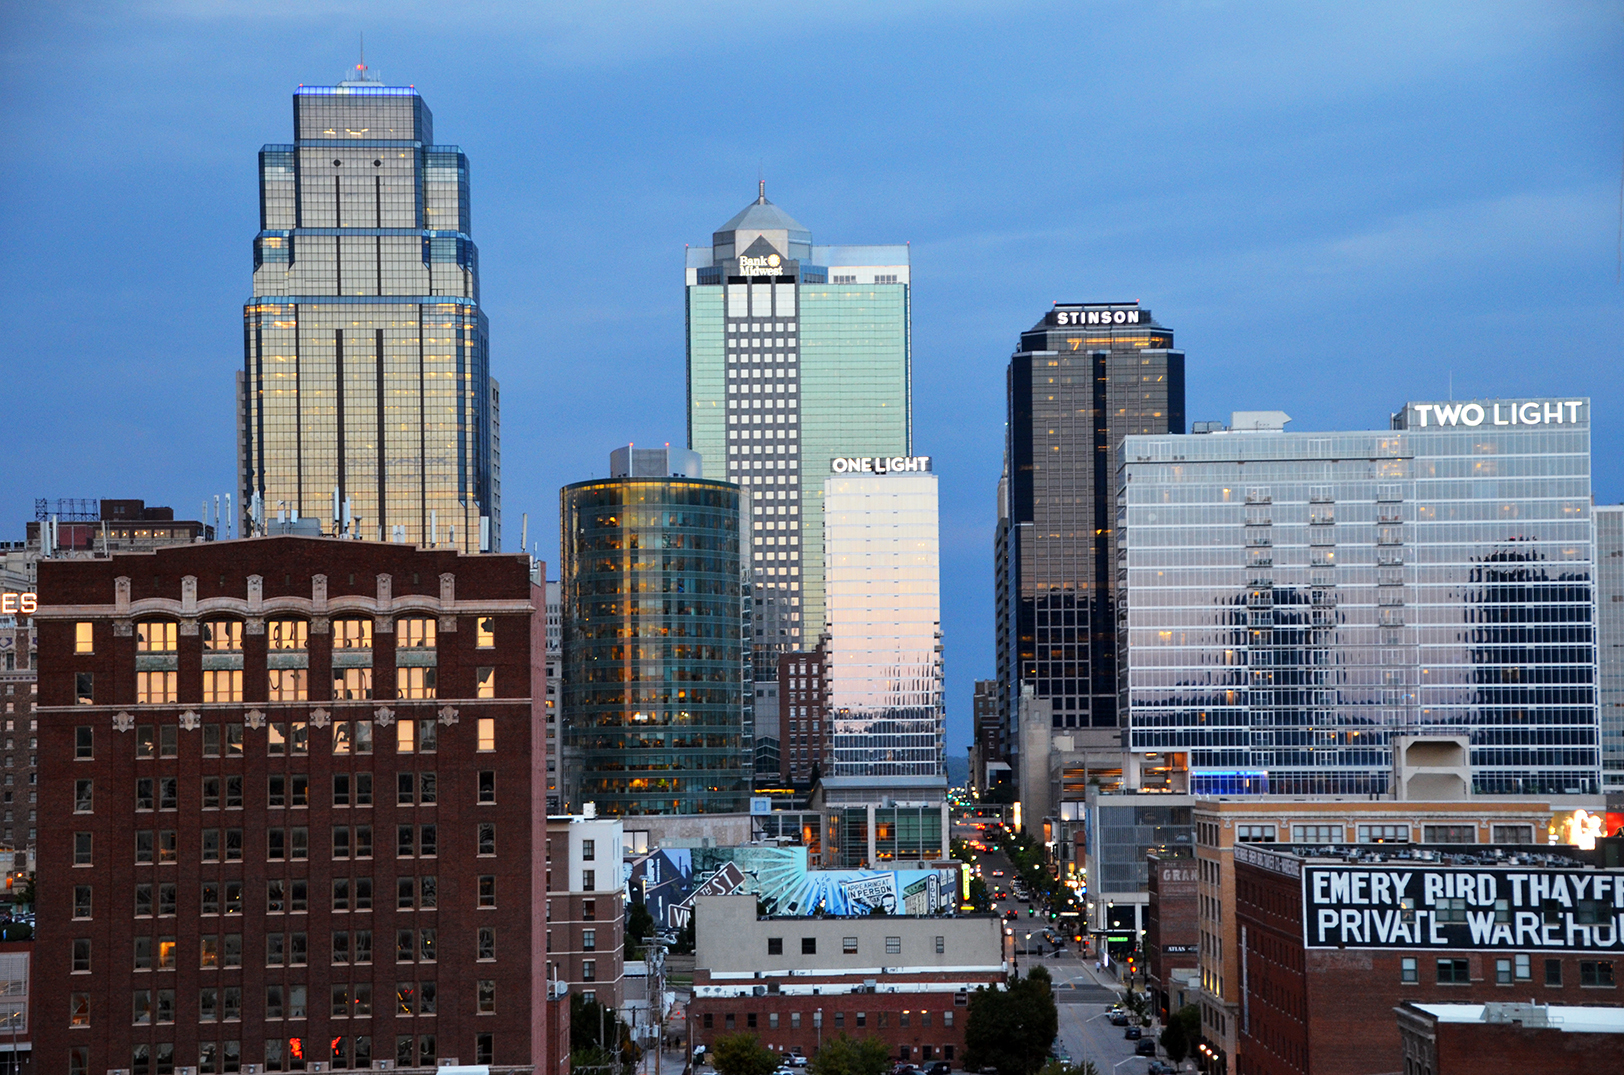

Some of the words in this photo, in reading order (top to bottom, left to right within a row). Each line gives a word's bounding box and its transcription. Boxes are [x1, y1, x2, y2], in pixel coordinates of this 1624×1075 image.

[740, 256, 767, 266] Bank
[740, 266, 783, 276] Midwest
[1057, 311, 1139, 324] STINSON
[1414, 403, 1485, 427] TWO
[1493, 401, 1583, 425] LIGHT
[832, 457, 872, 473] ONE
[875, 456, 930, 472] LIGHT
[2, 593, 38, 614] ES
[712, 868, 735, 896] ST
[857, 886, 892, 897] PERSON
[1312, 871, 1414, 904] EMERY
[1424, 872, 1497, 906] BIRD
[1318, 909, 1448, 944] PRIVATE
[1466, 911, 1624, 947] WAREHO
